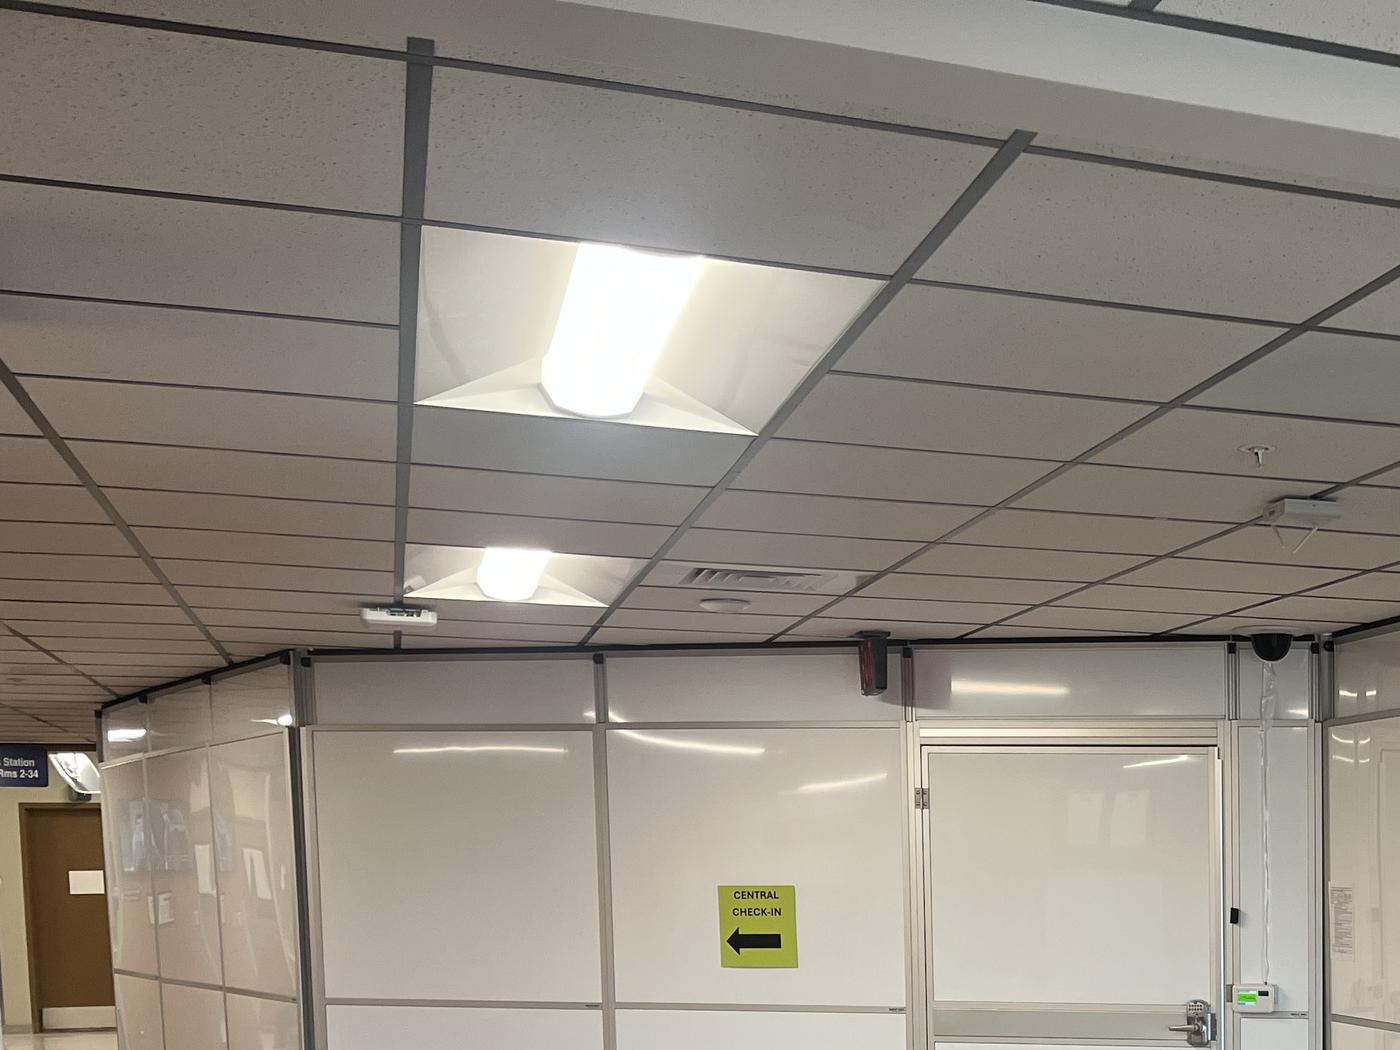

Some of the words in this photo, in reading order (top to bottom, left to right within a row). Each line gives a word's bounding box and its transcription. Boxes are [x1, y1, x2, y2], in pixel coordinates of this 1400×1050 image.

[3, 757, 35, 767] Station
[20, 769, 39, 778] 2-34
[733, 891, 779, 899] CENTRAL
[732, 908, 782, 916] CHECK-IN
